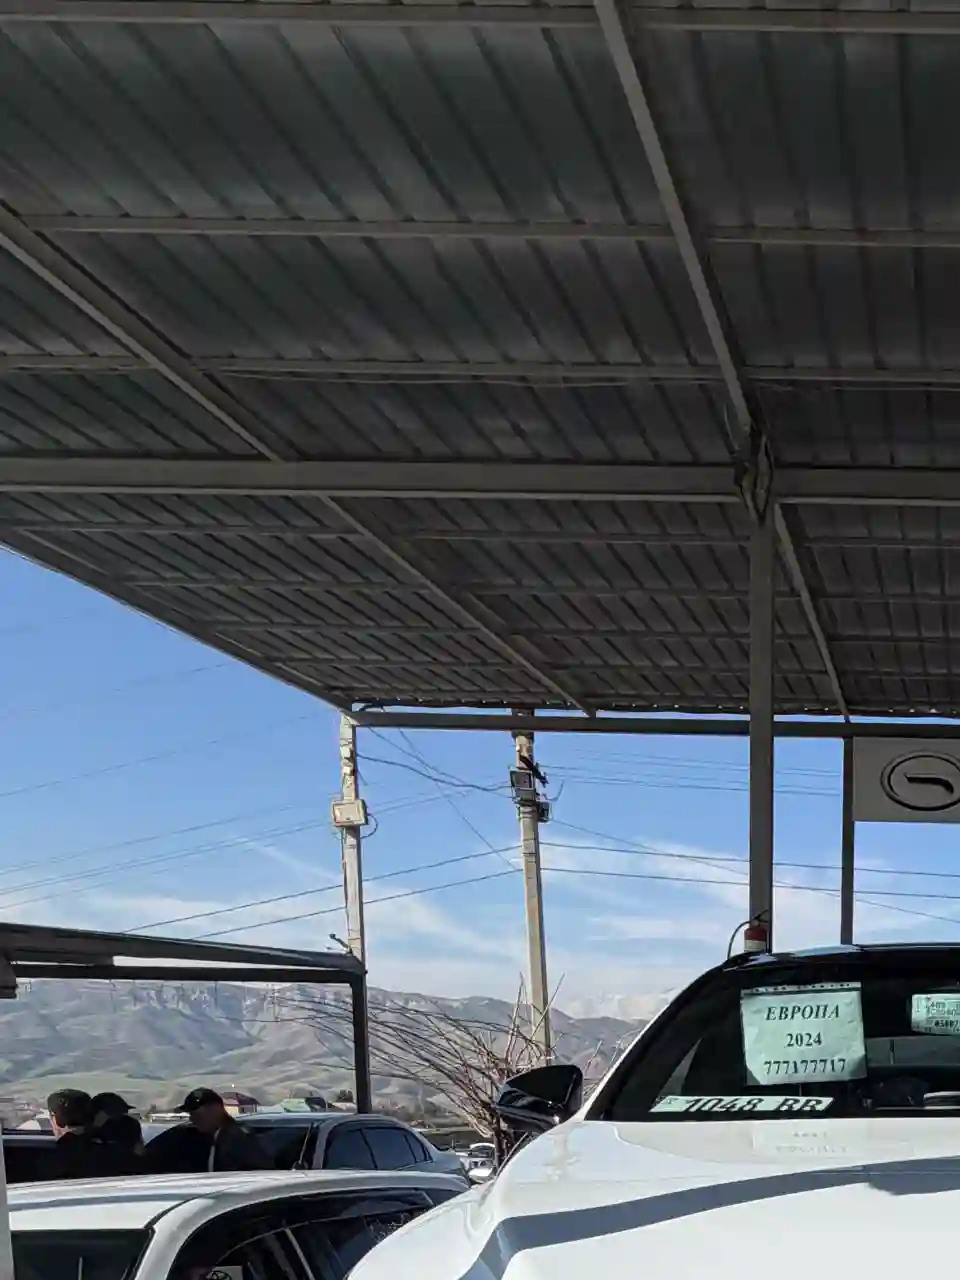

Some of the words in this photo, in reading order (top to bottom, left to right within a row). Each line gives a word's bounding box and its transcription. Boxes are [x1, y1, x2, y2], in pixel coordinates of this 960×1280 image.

[765, 1004, 841, 1021] ЕВРОПА
[785, 1032, 823, 1048] 2024
[763, 1058, 847, 1076] 777177717
